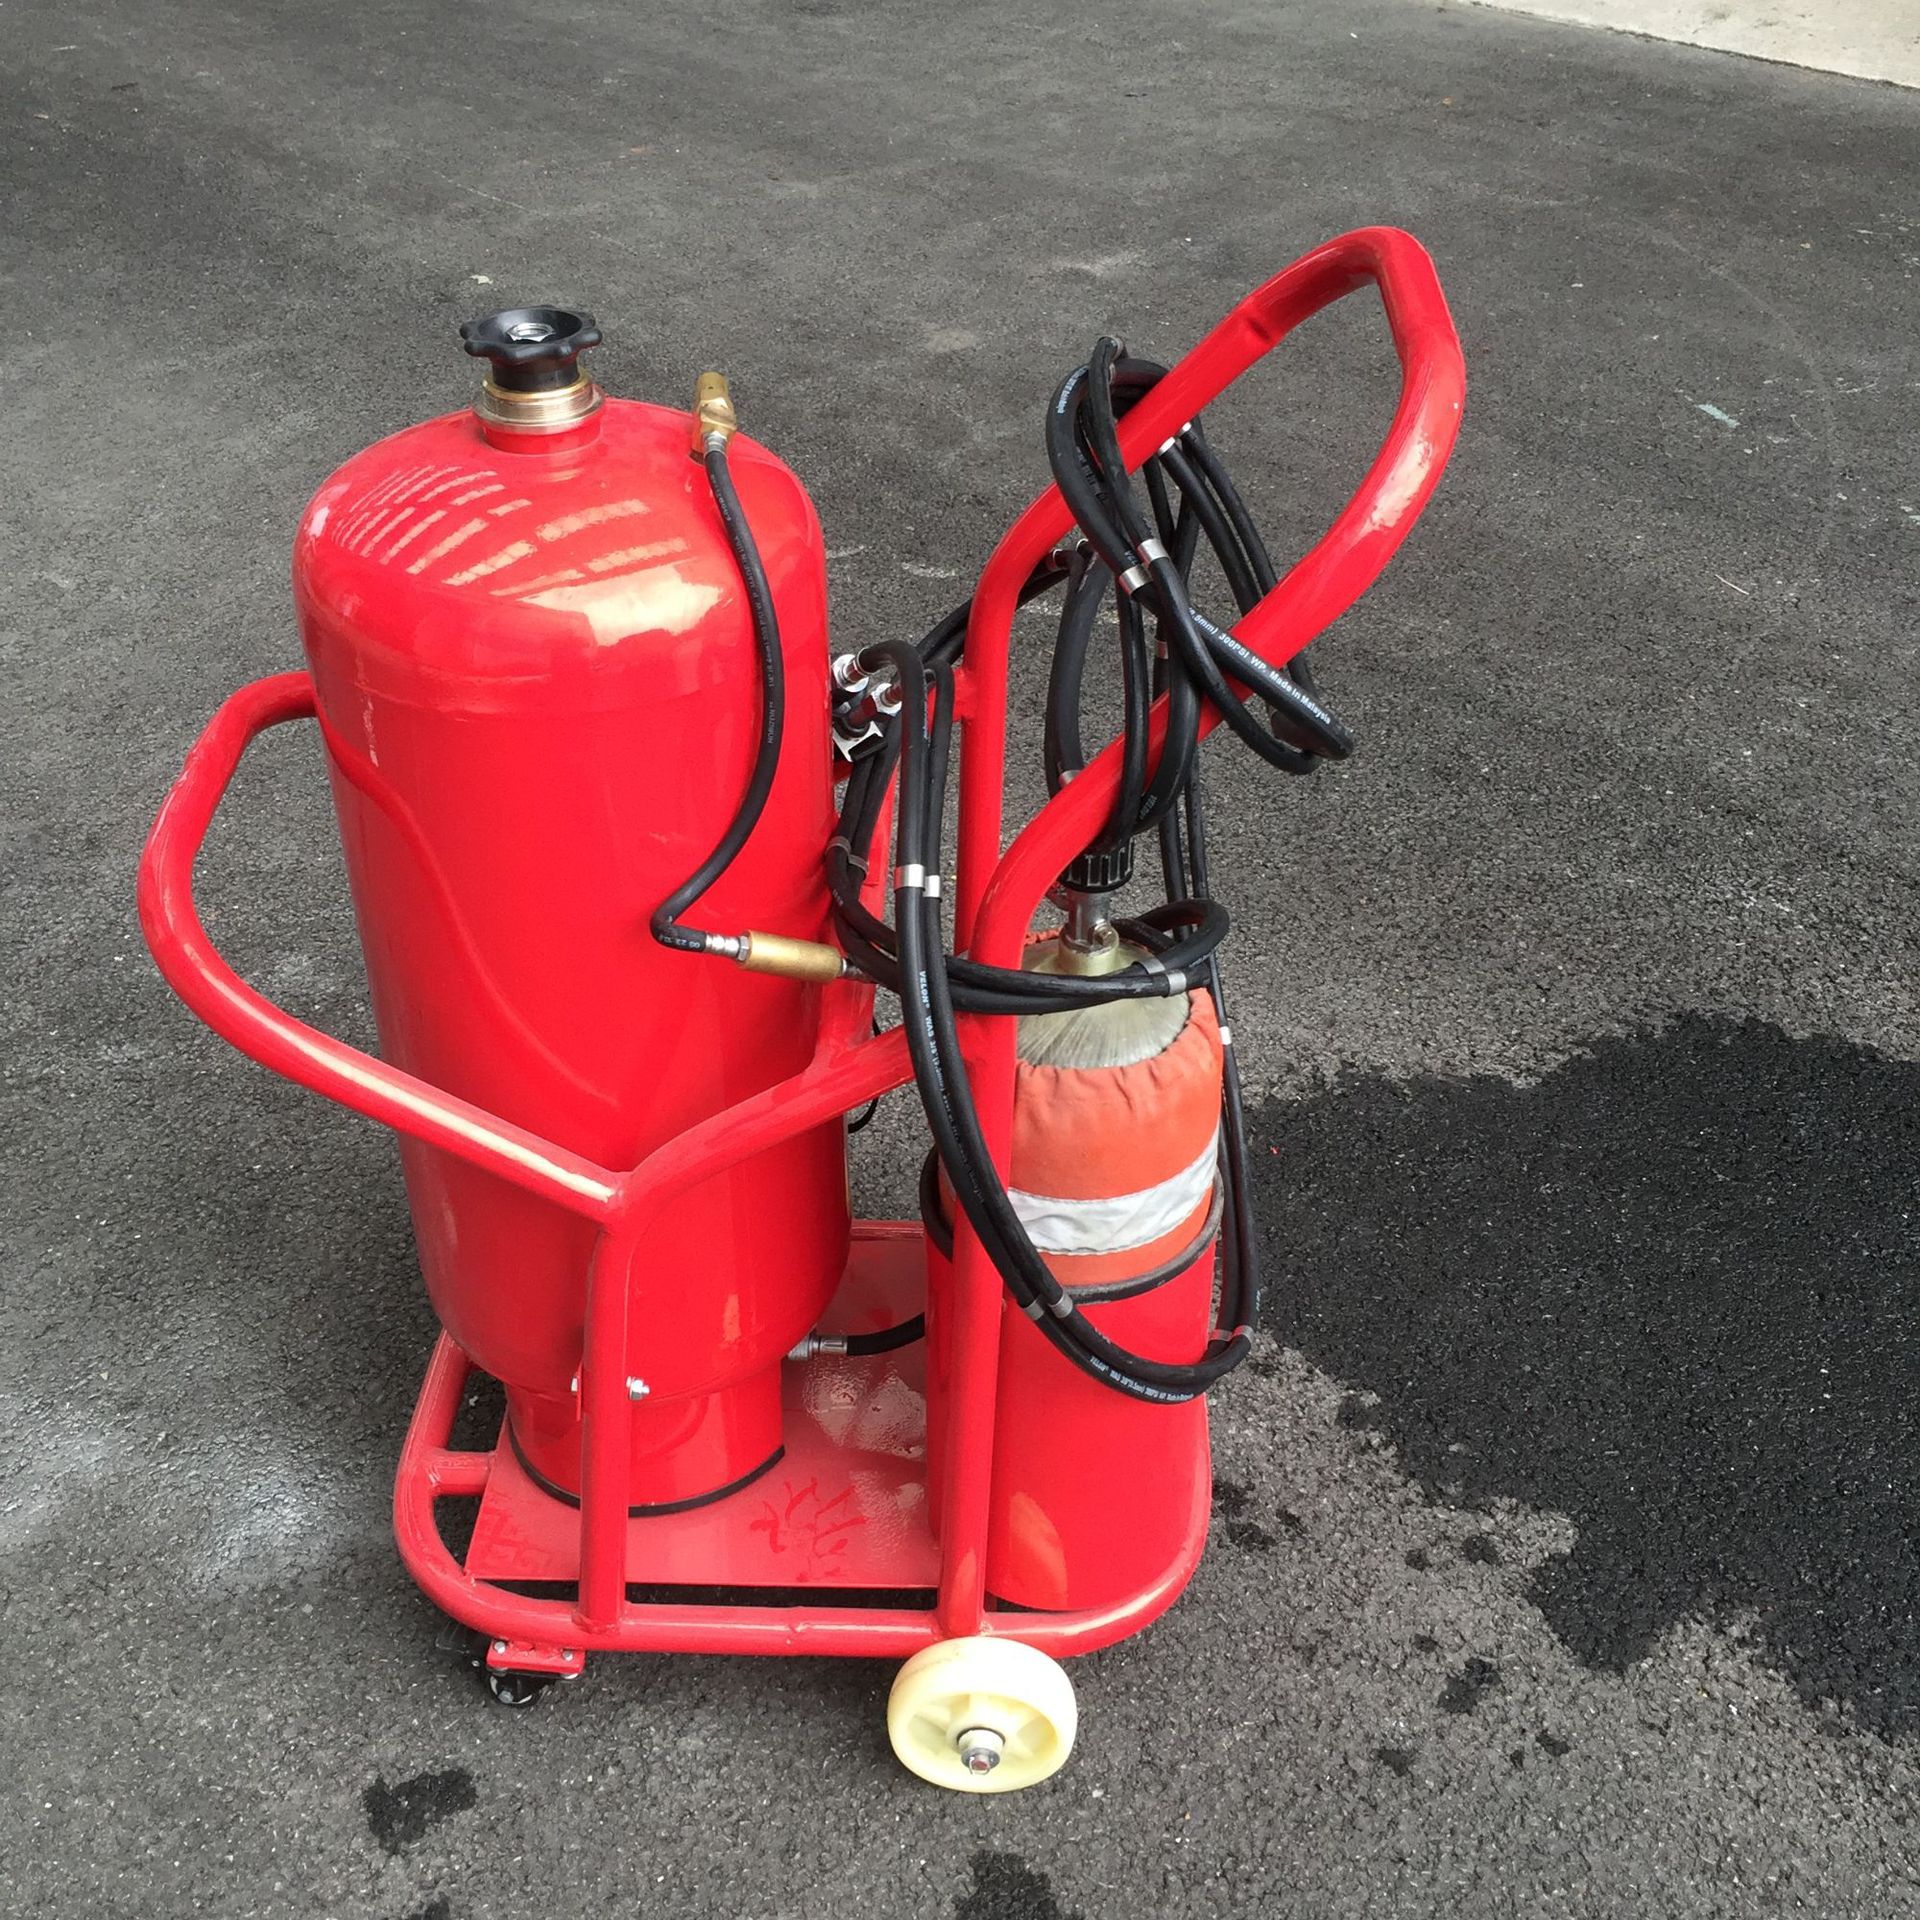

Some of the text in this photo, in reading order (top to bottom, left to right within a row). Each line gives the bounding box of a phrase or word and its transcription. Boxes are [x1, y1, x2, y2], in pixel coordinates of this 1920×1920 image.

[1218, 633, 1250, 658] 300PSI
[1269, 671, 1291, 692] Made
[1300, 696, 1331, 725] Malaysia
